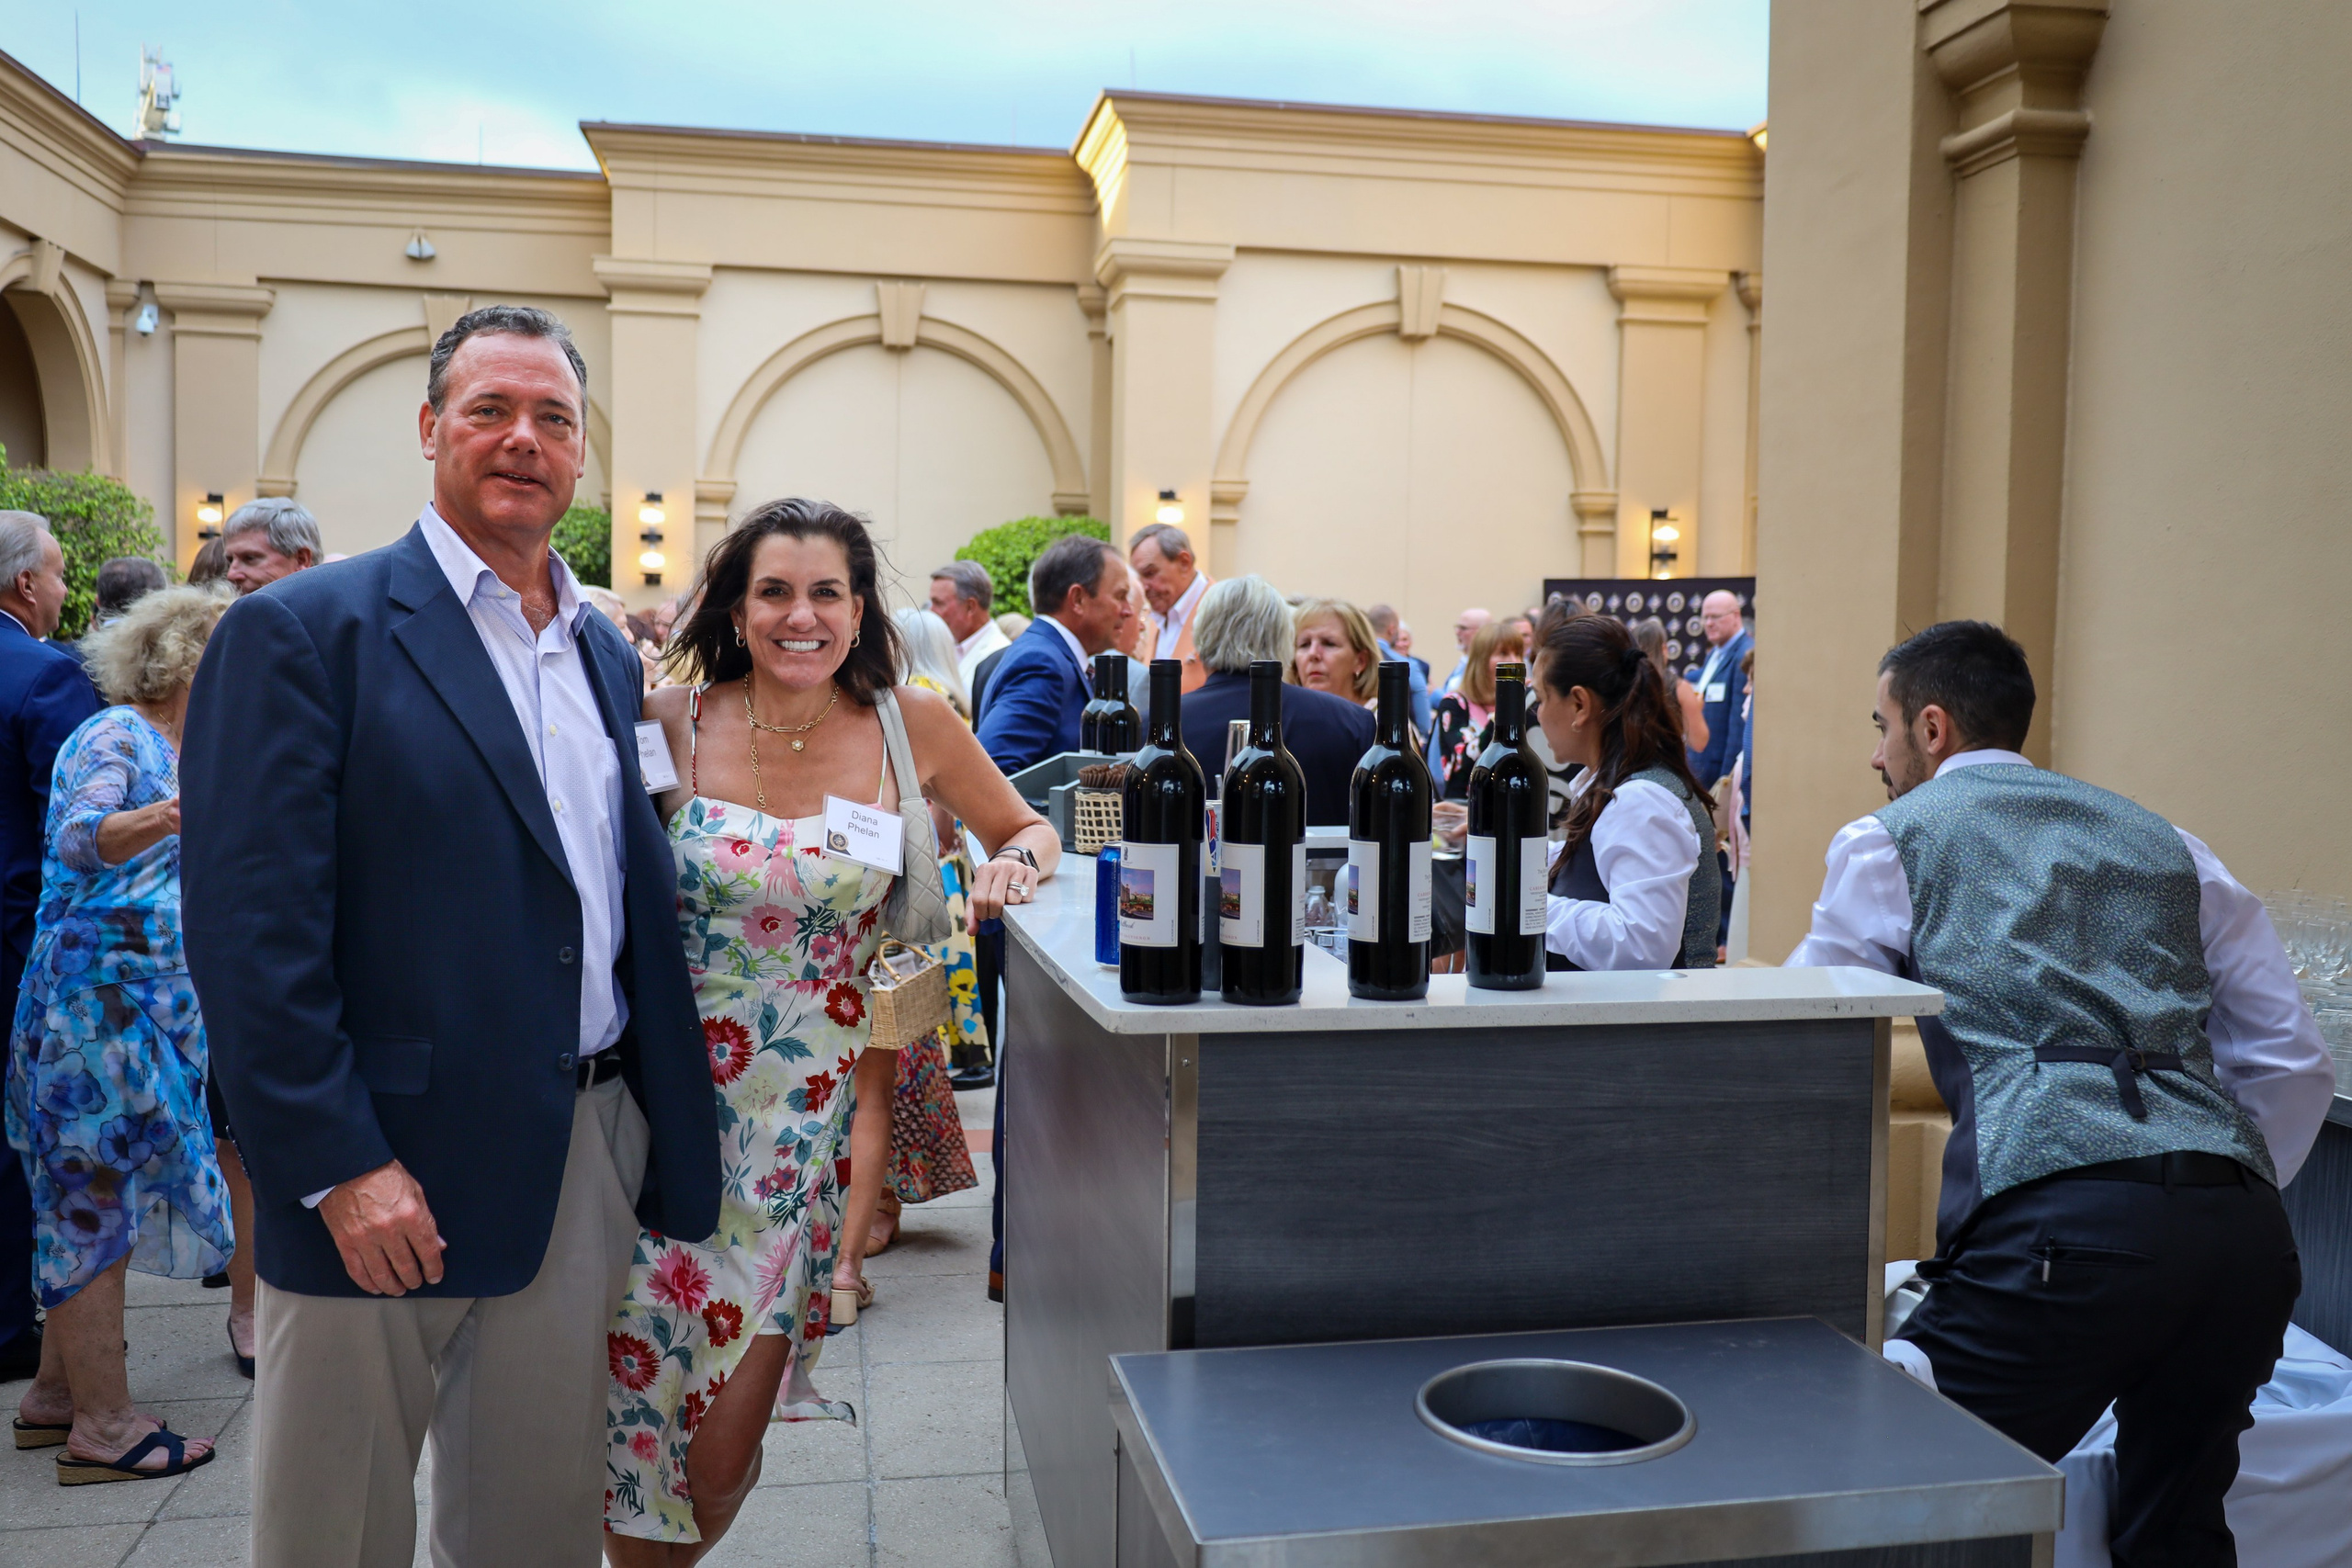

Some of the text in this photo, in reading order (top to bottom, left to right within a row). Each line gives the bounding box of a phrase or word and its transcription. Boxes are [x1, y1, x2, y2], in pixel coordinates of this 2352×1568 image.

[636, 735, 649, 745] Tom
[851, 810, 878, 826] Diana
[847, 822, 880, 839] Phelan
